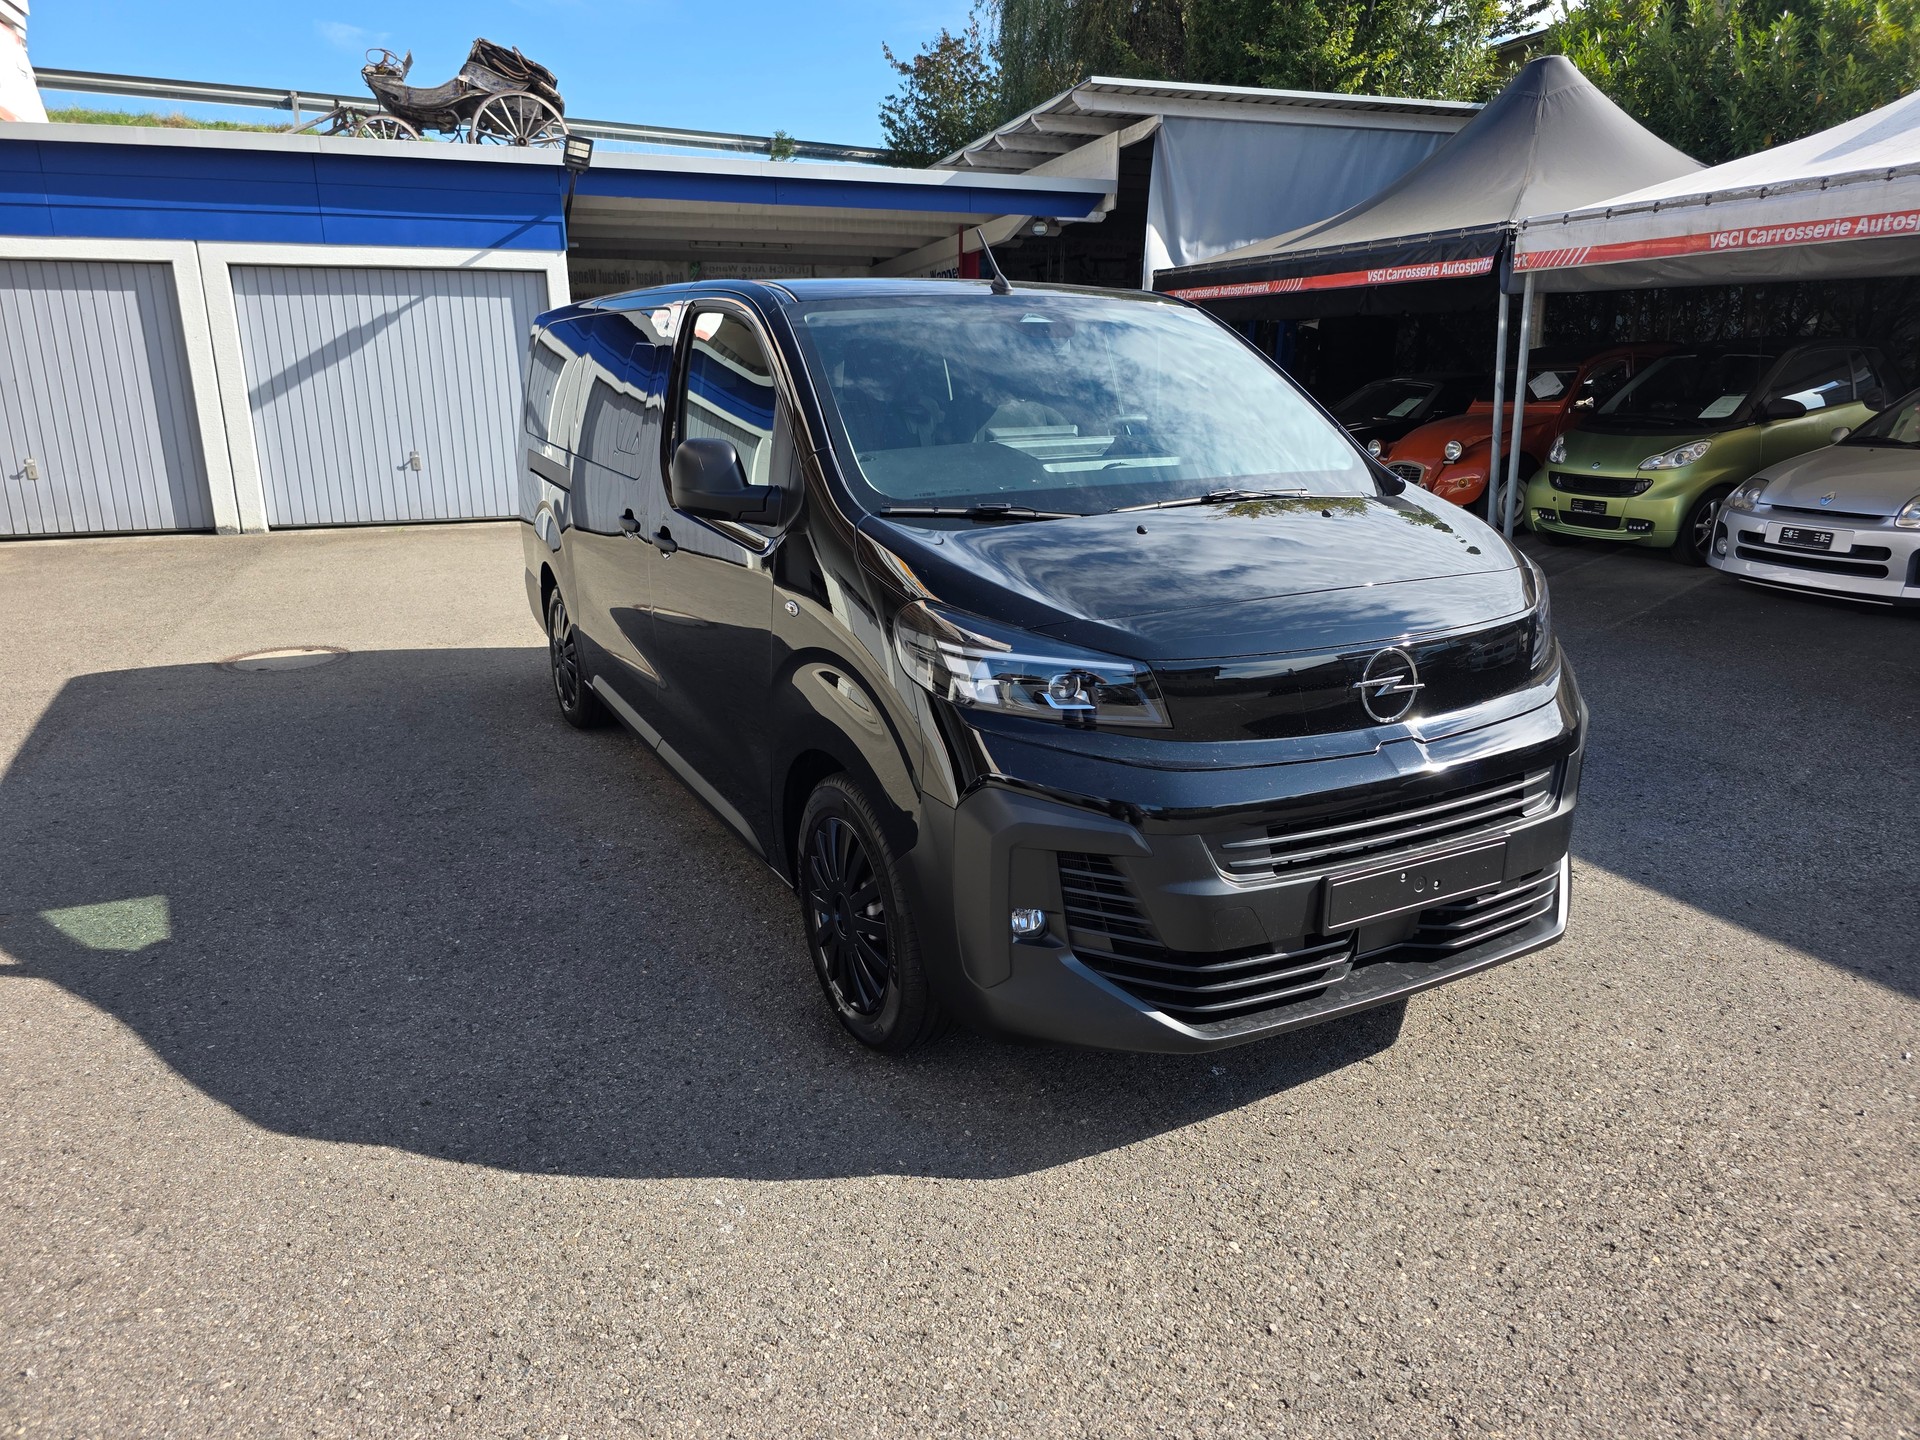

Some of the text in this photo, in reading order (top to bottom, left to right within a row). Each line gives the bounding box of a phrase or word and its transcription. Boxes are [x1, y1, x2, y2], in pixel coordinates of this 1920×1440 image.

[1710, 232, 1743, 249] VSCI
[1747, 219, 1852, 245] Carrosserie
[1367, 270, 1385, 282] VSCI
[1386, 264, 1439, 281] Carrosserie
[1186, 287, 1219, 299] Carrosserie
[1219, 282, 1270, 297] Autospritzwerk
